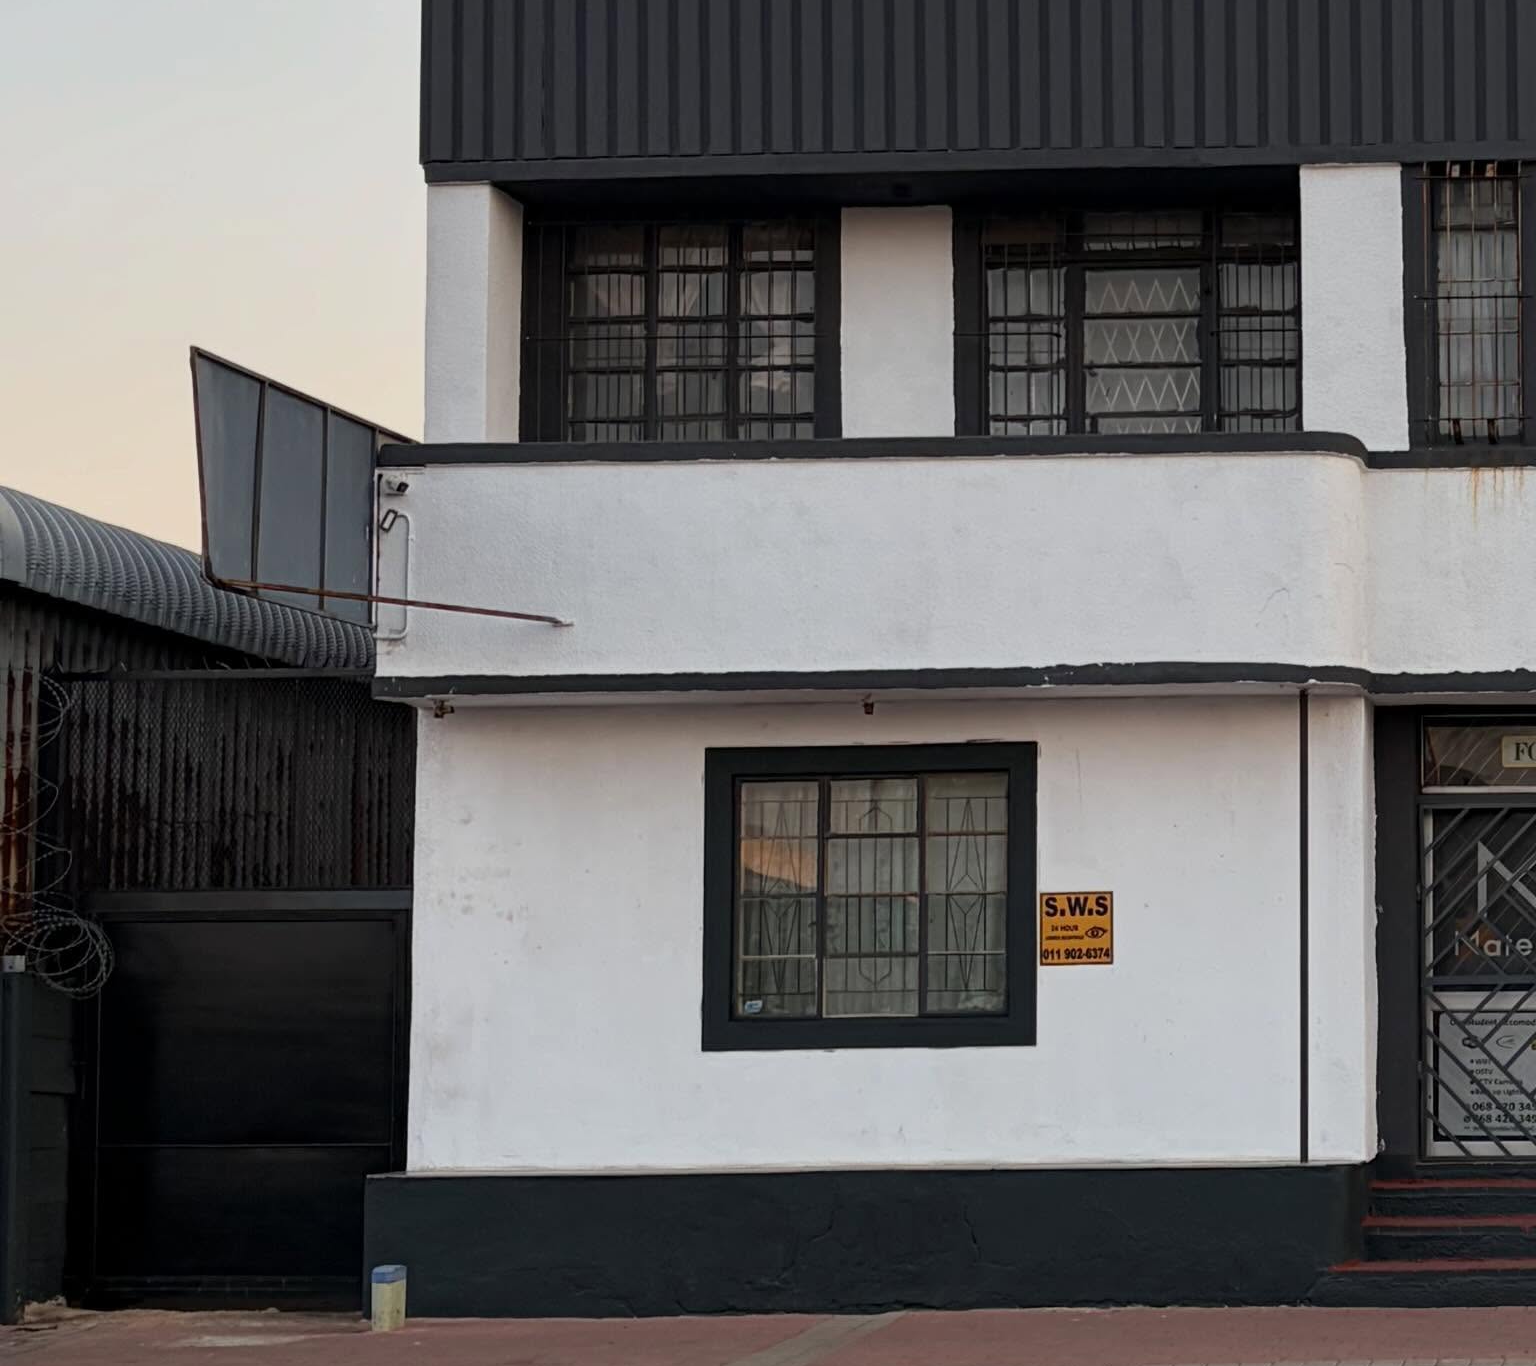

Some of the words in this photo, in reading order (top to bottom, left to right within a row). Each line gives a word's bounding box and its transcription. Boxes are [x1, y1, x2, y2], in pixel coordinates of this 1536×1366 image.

[1045, 895, 1109, 917] S.W.S
[1043, 948, 1061, 960] 011
[1064, 947, 1110, 960] 902-6374
